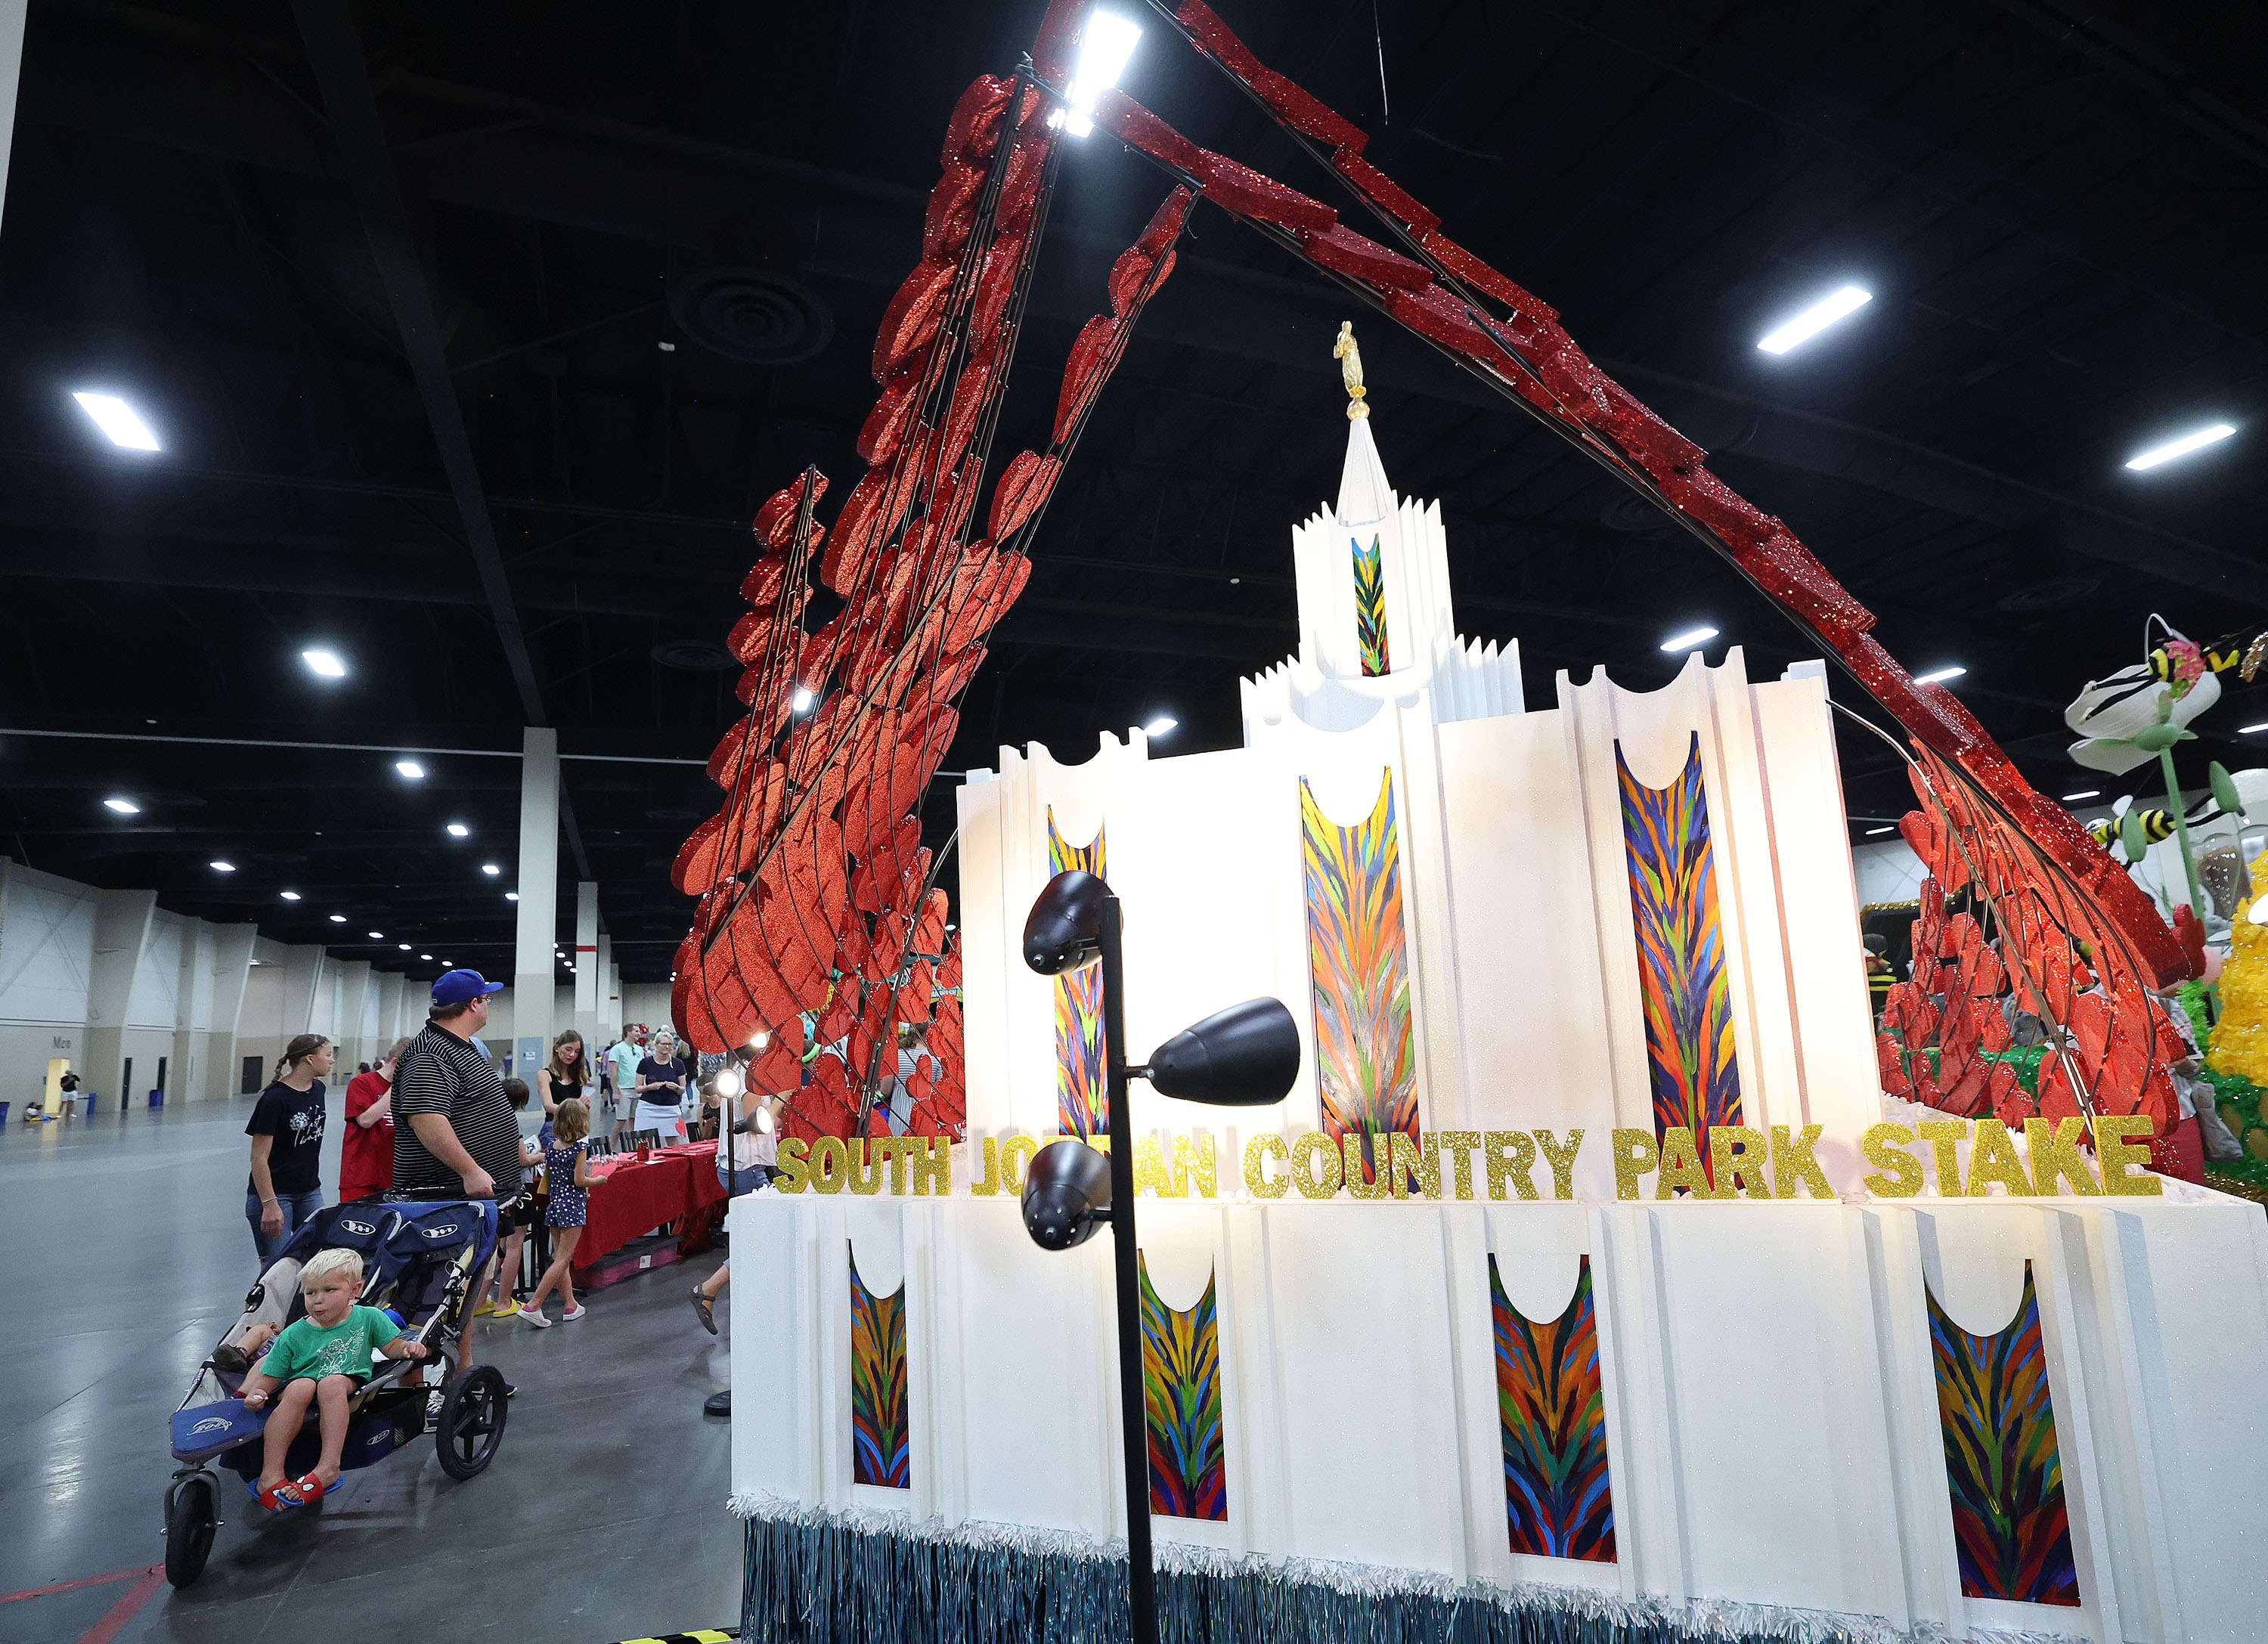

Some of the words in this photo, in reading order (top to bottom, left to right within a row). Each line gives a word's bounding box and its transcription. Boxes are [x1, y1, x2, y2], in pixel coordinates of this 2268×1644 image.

[775, 1135, 951, 1195] SOUTH
[971, 1134, 1217, 1198] JOAN
[1244, 1129, 1586, 1200] COUNTRY
[1611, 1124, 1838, 1200] PARK
[1861, 1115, 2162, 1198] STAKE
